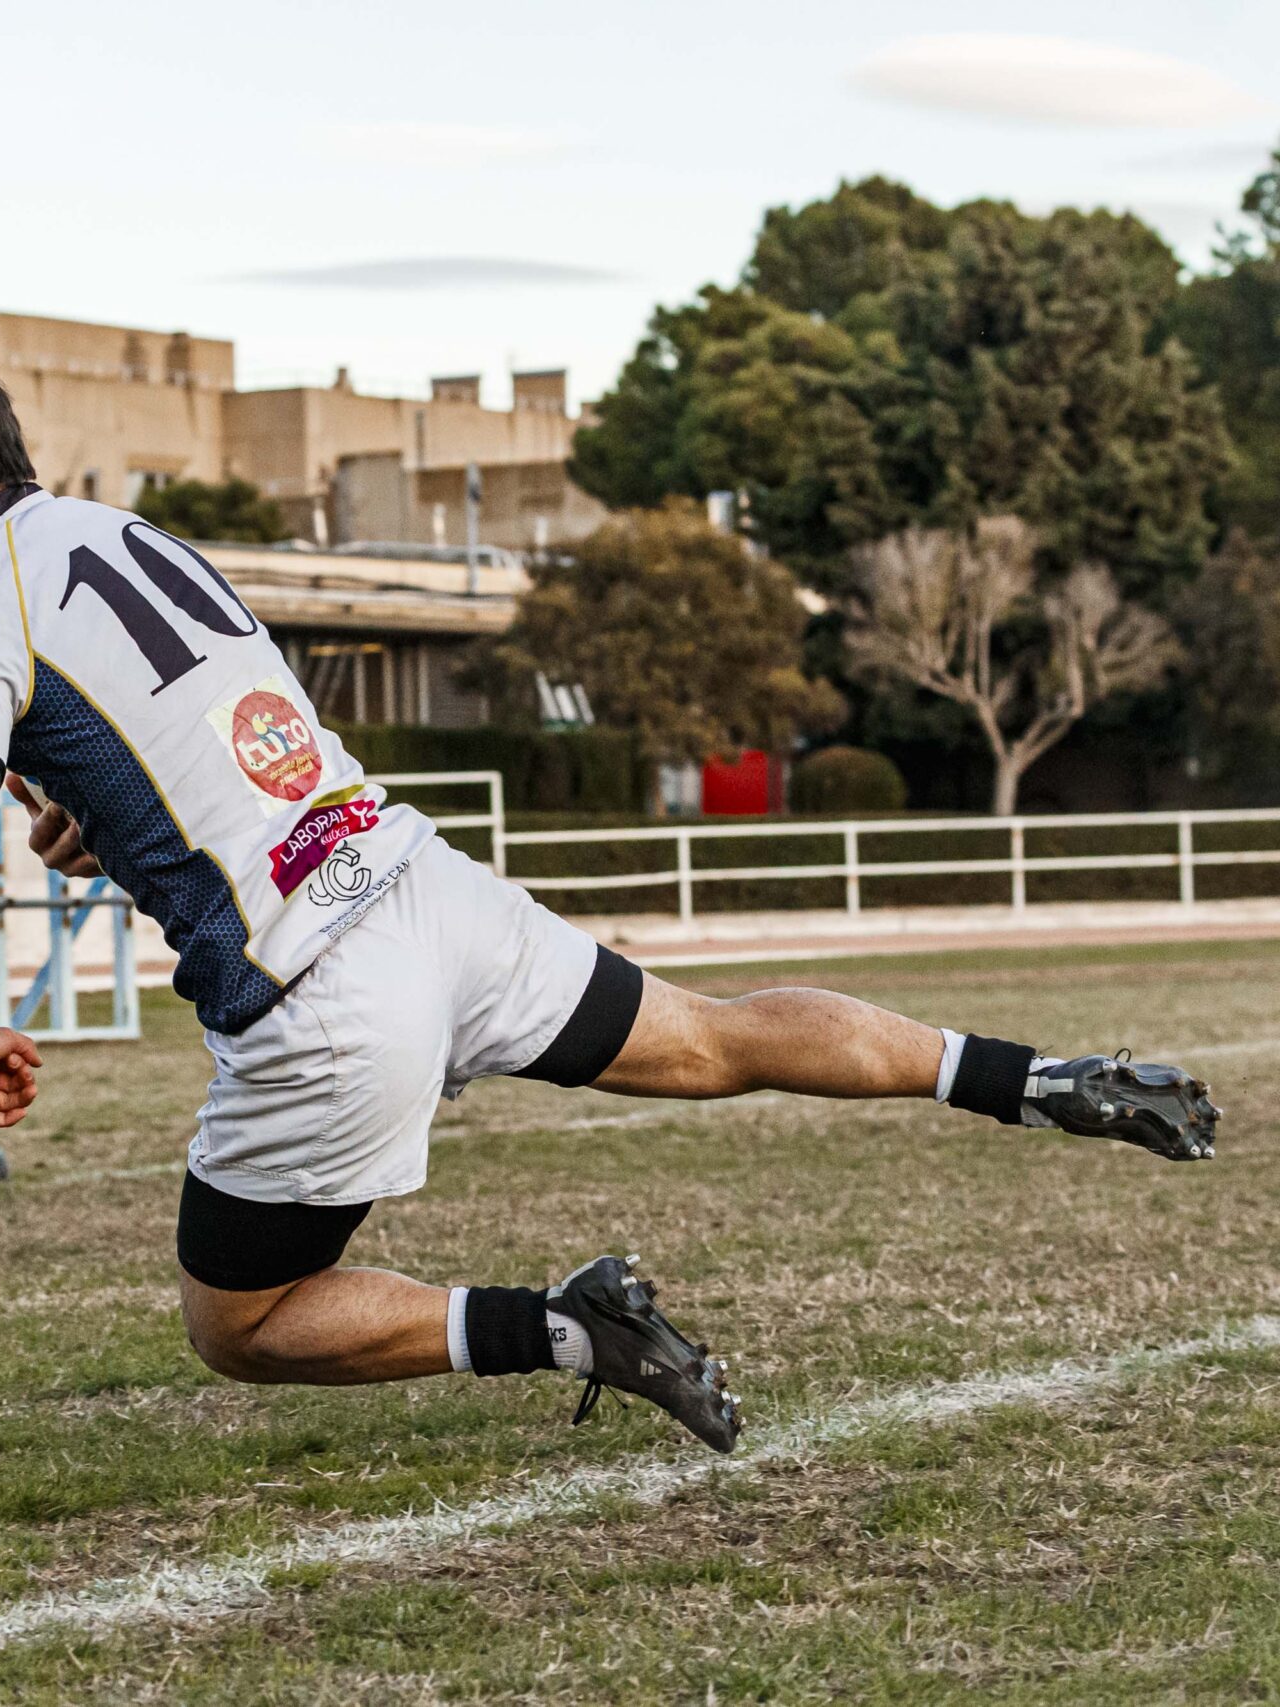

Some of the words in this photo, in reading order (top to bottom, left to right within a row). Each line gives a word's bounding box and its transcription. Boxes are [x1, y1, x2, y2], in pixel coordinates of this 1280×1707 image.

[58, 520, 259, 697] 10
[236, 718, 311, 771] tuco
[280, 808, 349, 865] LABORAL
[320, 825, 350, 845] kutxa
